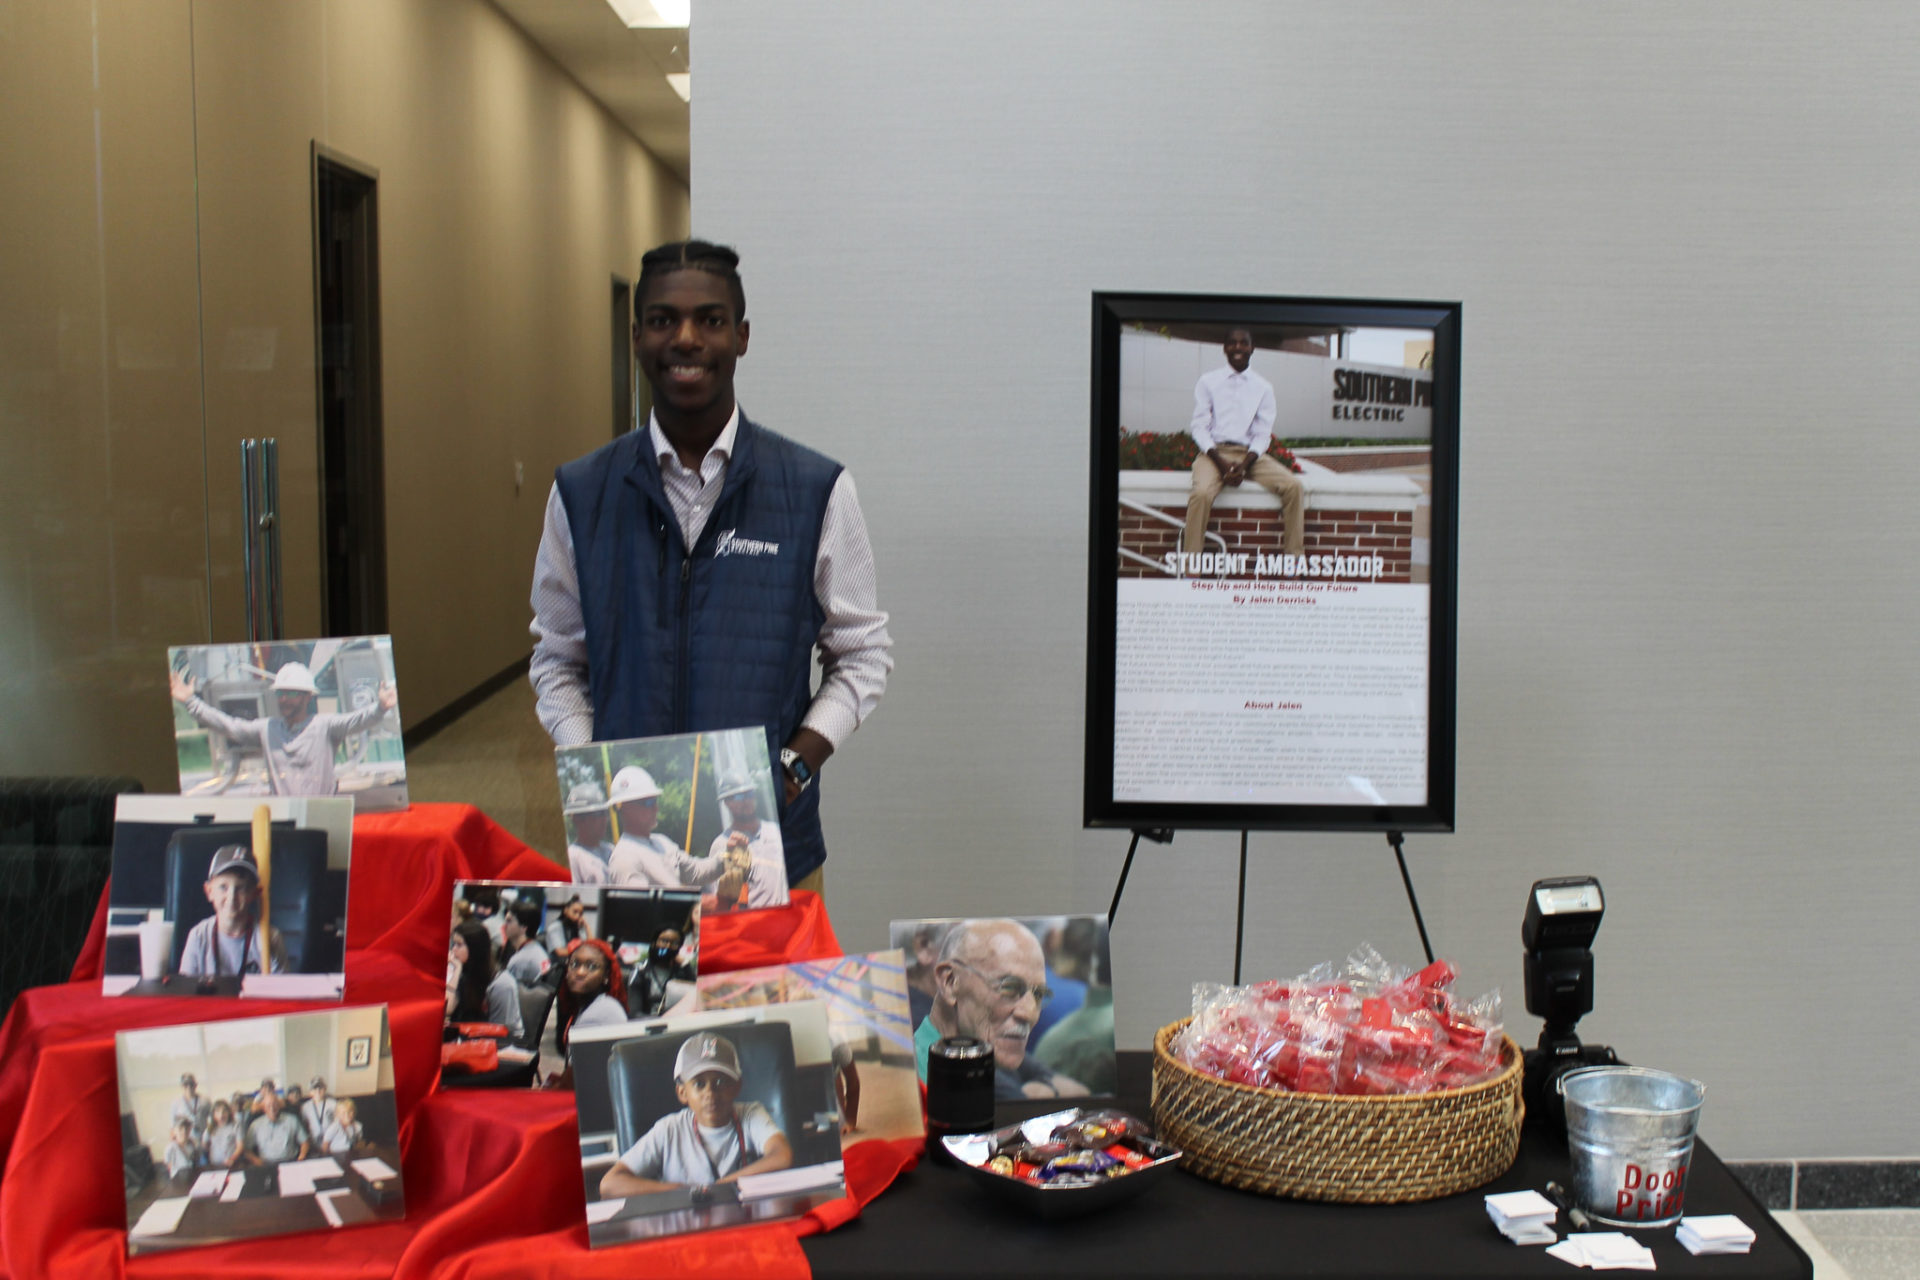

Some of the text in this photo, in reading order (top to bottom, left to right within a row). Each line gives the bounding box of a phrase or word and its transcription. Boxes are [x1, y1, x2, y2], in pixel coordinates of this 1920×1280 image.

[1332, 405, 1405, 422] ELECTRIC
[1164, 551, 1384, 578] STUDENT AMBASSADOR
[1192, 581, 1214, 591] Step
[1217, 580, 1230, 591] Up
[1233, 581, 1251, 590] and
[1254, 581, 1276, 592] Help
[1279, 582, 1304, 591] Build
[1307, 583, 1323, 592] Our
[1233, 595, 1246, 605] By
[1244, 700, 1274, 710] About
[1555, 1046, 1579, 1055] Canon
[1624, 1163, 1687, 1192] Door
